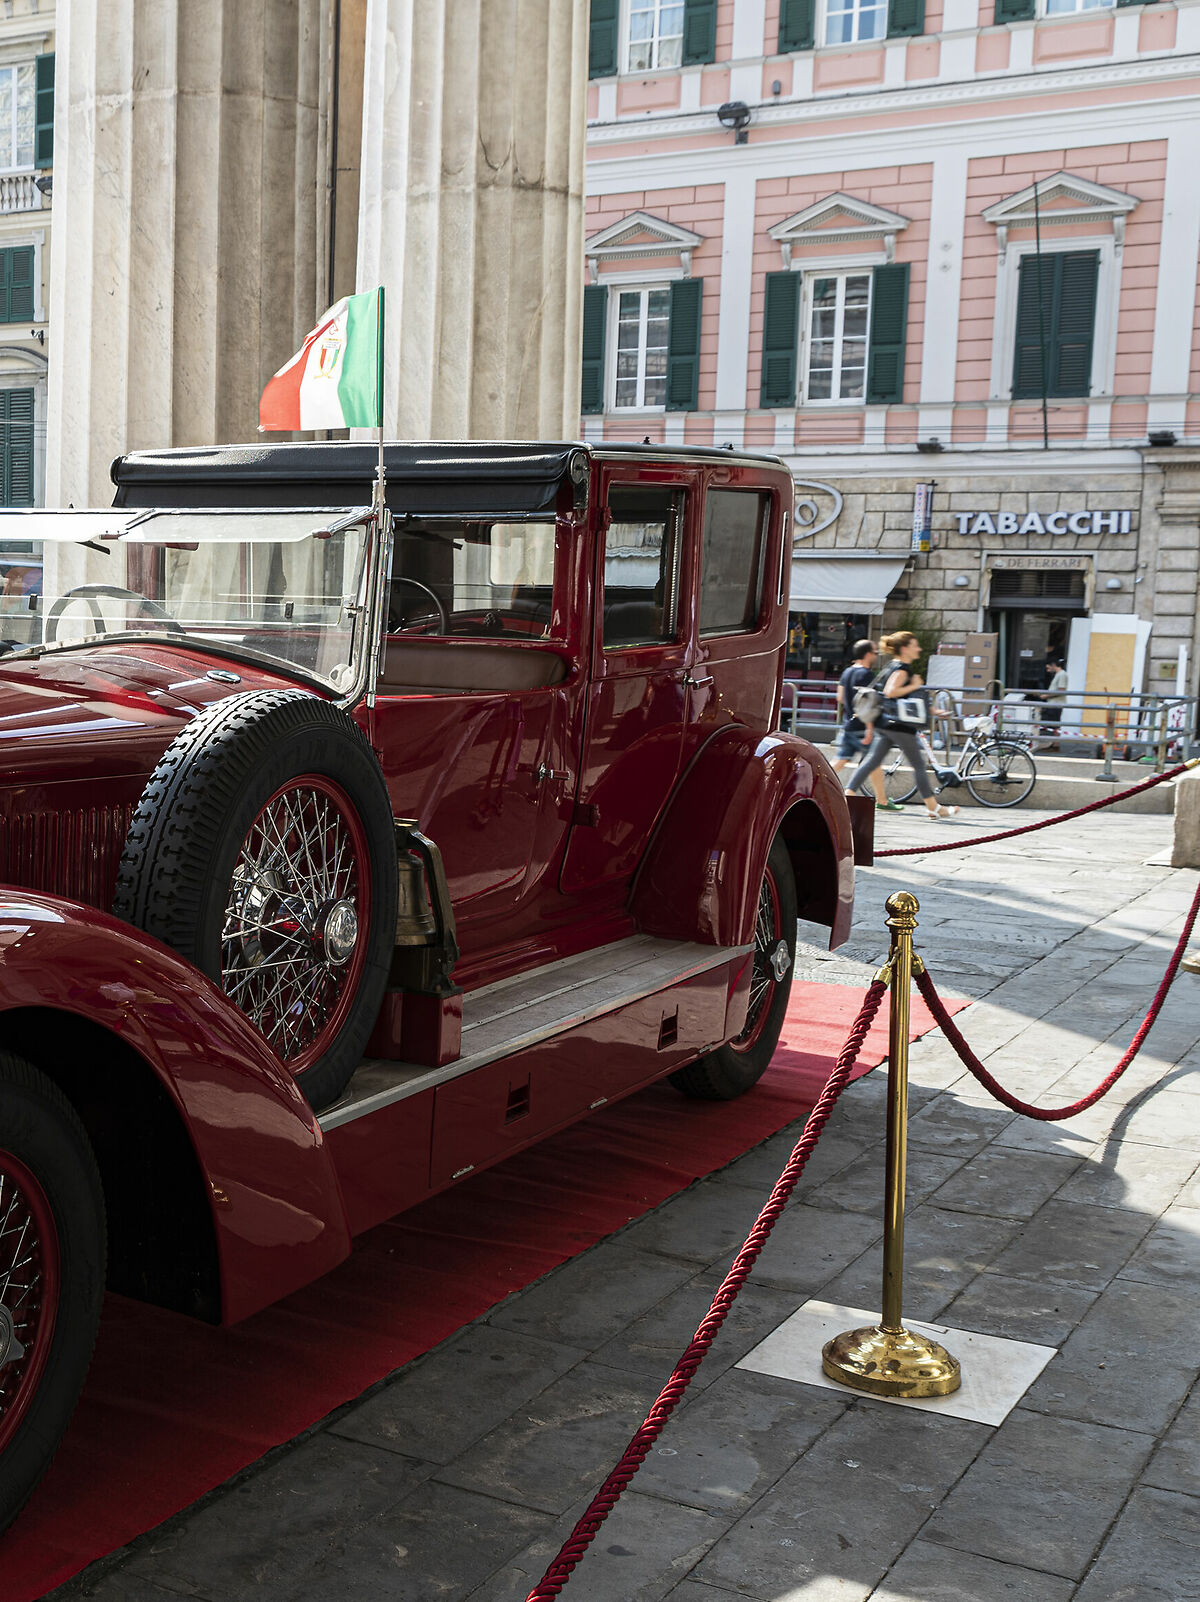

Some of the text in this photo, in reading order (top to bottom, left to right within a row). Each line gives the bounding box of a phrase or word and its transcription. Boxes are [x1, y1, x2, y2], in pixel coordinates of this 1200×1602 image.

[955, 511, 1131, 535] TABACCHI
[1007, 557, 1081, 568] DE FERRARI
